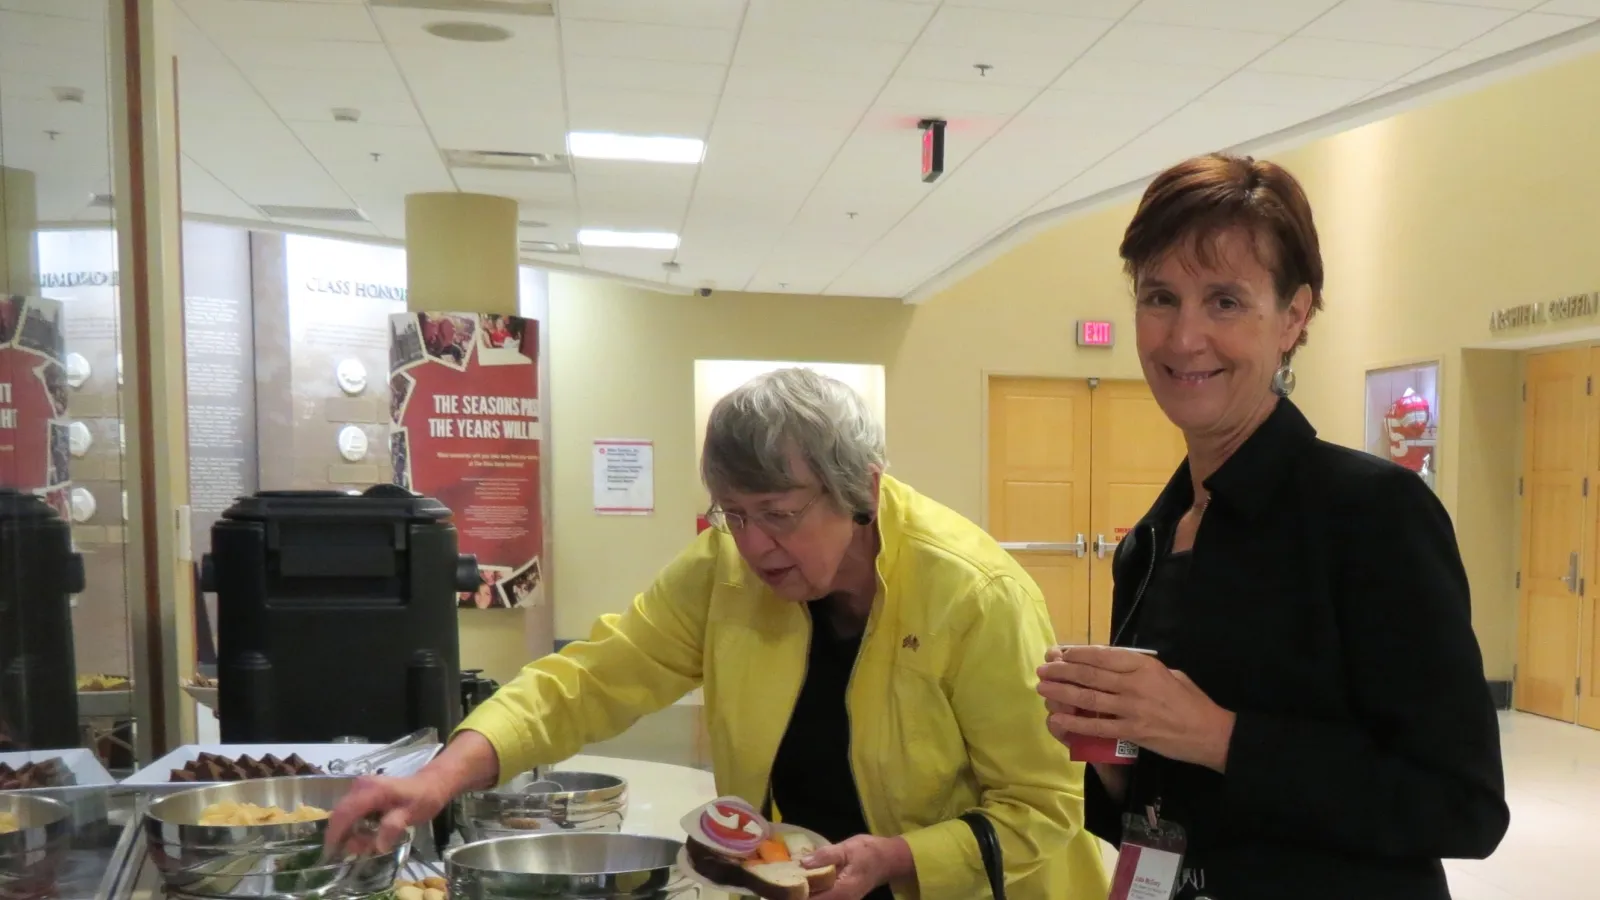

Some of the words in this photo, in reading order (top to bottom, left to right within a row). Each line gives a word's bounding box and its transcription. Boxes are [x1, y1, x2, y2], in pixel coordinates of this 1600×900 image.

[306, 277, 350, 296] CLASS
[1084, 321, 1110, 342] EXIT
[433, 394, 459, 414] THE
[462, 395, 522, 416] SEASONS
[428, 418, 454, 438] THE
[456, 419, 501, 439] YEARS
[502, 421, 529, 440] WILL
